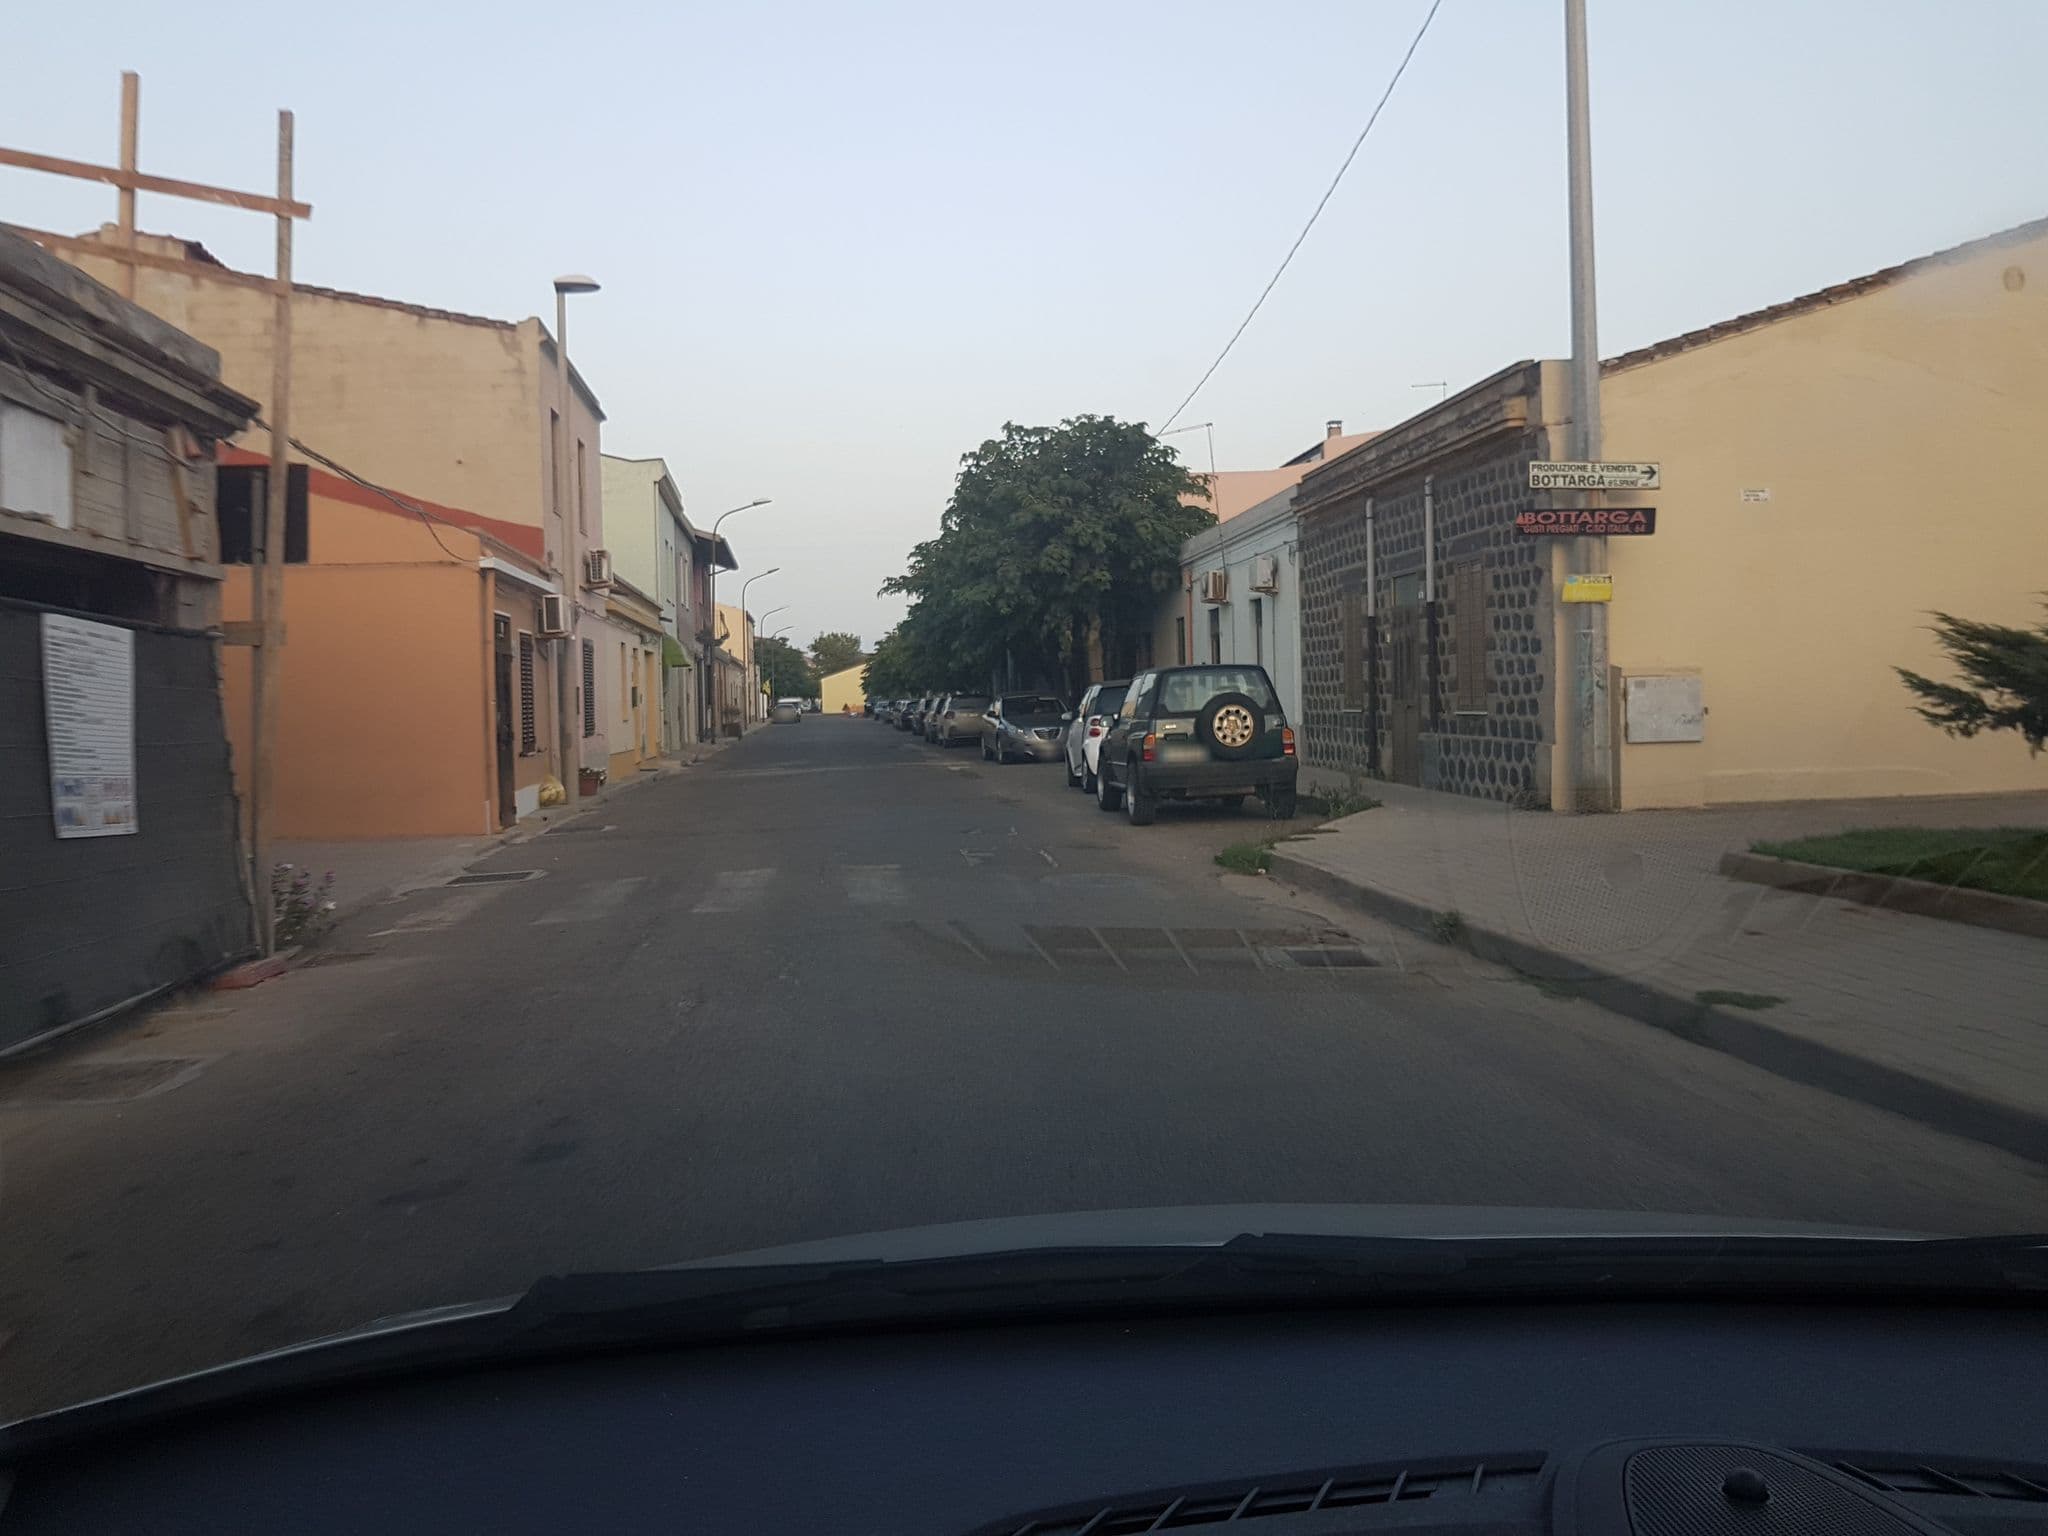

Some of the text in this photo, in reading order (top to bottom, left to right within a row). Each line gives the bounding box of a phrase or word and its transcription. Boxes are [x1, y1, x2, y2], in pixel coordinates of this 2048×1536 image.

[1531, 464, 1588, 472] PRODUZIONE
[1599, 464, 1637, 473] VENDITA
[1532, 474, 1605, 487] BOTTARGA
[1523, 511, 1648, 524] BOTTARGA
